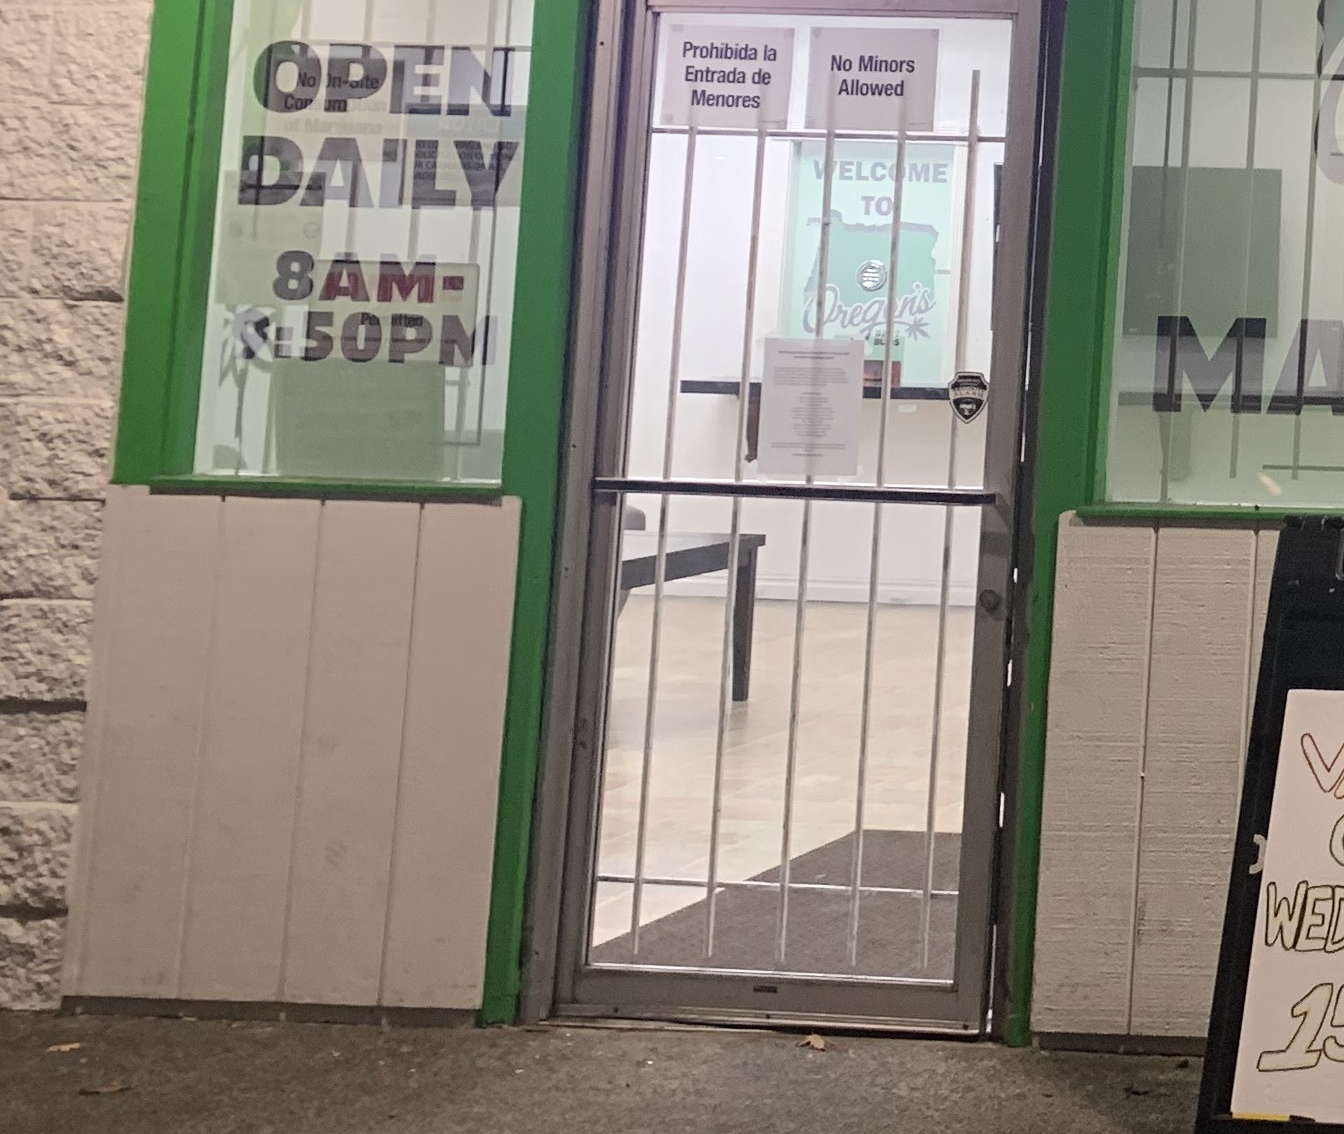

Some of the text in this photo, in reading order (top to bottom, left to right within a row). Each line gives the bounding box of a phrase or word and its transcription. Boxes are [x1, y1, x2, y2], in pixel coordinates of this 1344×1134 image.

[682, 40, 777, 63] Prohibida la
[685, 65, 771, 86] Entrada de
[830, 54, 915, 74] No Minors
[253, 40, 517, 117] OPEN
[838, 78, 904, 98] Allowed
[691, 89, 760, 110] Menores
[238, 134, 520, 211] DAILY
[813, 158, 949, 184] WELCOME
[861, 194, 896, 217] TO
[272, 250, 464, 304] 8AM-
[802, 281, 936, 340] Oregn's
